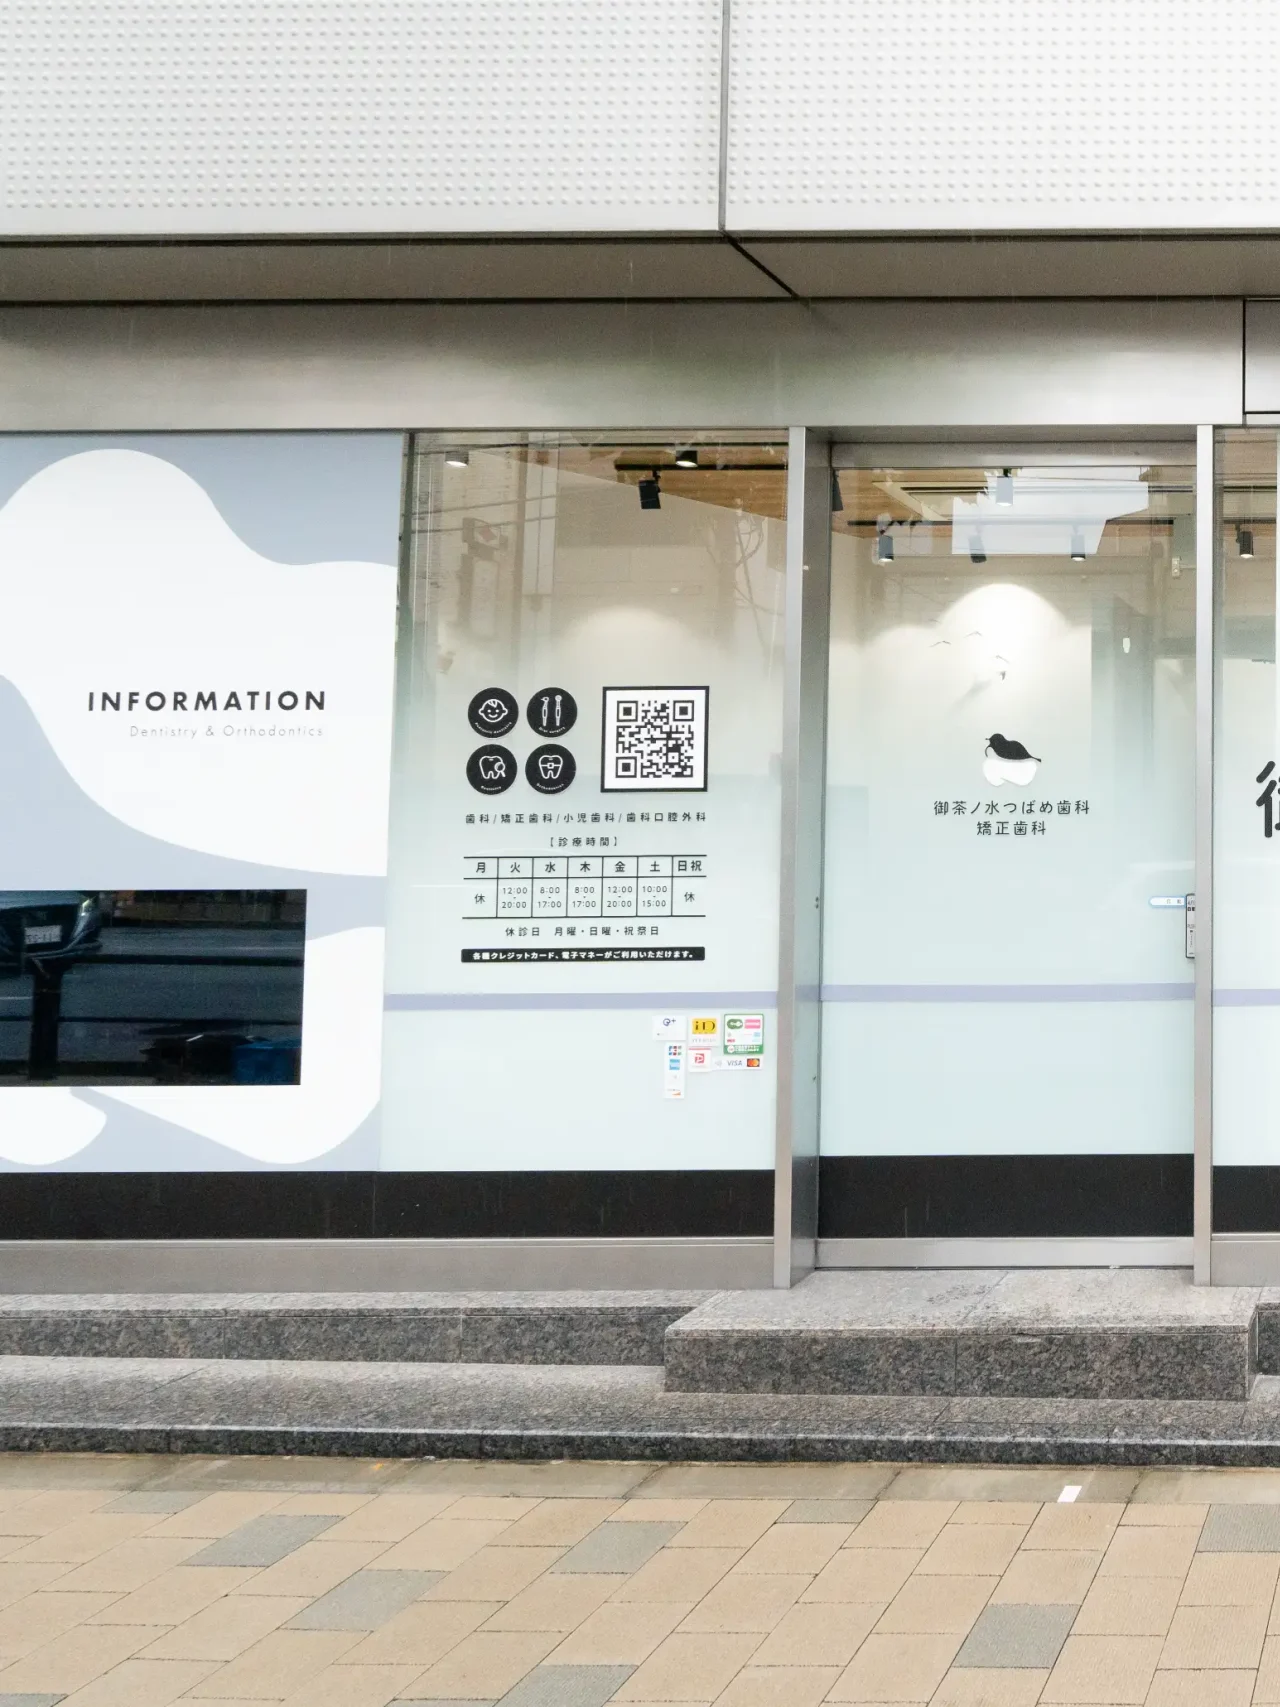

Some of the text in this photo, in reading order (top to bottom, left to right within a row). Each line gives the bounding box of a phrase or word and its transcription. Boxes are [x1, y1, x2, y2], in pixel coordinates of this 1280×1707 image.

[88, 690, 325, 712] INFORMATION
[130, 724, 323, 740] Dentistry & Orthodontics
[933, 799, 1090, 816] 御茶ノ水つばめ歯科
[976, 820, 1046, 836] 矯正歯科
[475, 860, 702, 874] 月 火 水 木 金 土 日祝
[502, 885, 668, 895] 12:00 8:00 8:00 12:00 10:00
[474, 891, 696, 904] 休 休
[501, 899, 667, 909] 20:00 17:00 17:00 20:00 15:00
[505, 927, 541, 937] 休診日
